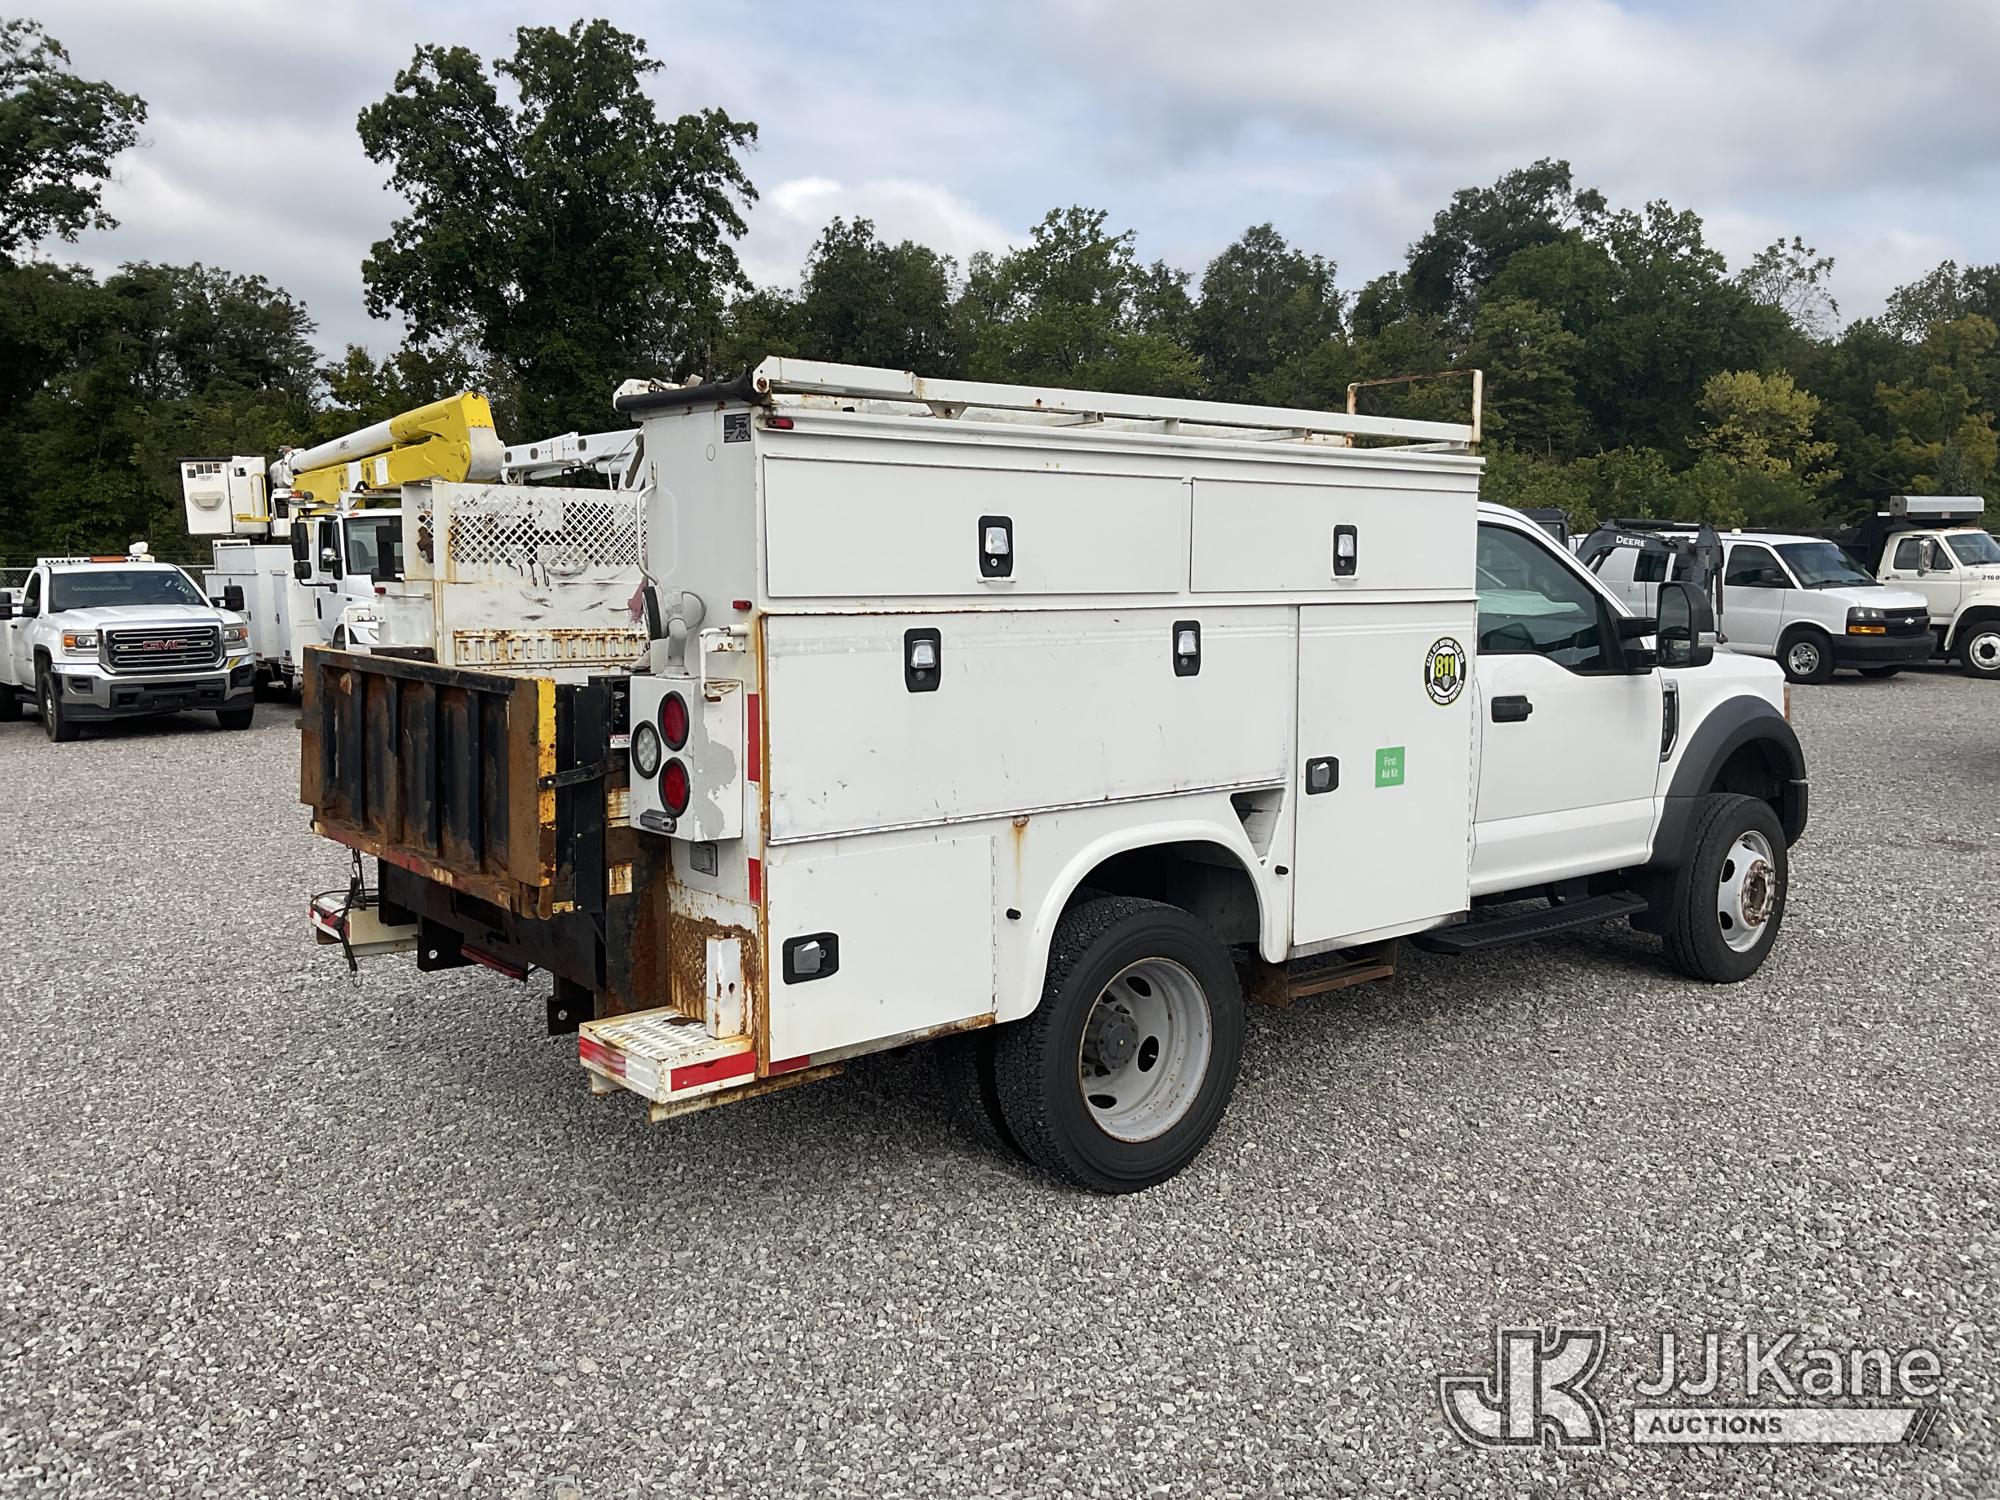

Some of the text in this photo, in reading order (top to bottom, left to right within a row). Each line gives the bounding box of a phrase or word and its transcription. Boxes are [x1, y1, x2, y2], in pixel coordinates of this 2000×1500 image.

[1616, 535, 1645, 547] DEERE
[143, 639, 187, 651] GMC
[1435, 653, 1455, 678] 811
[1384, 756, 1396, 766] First
